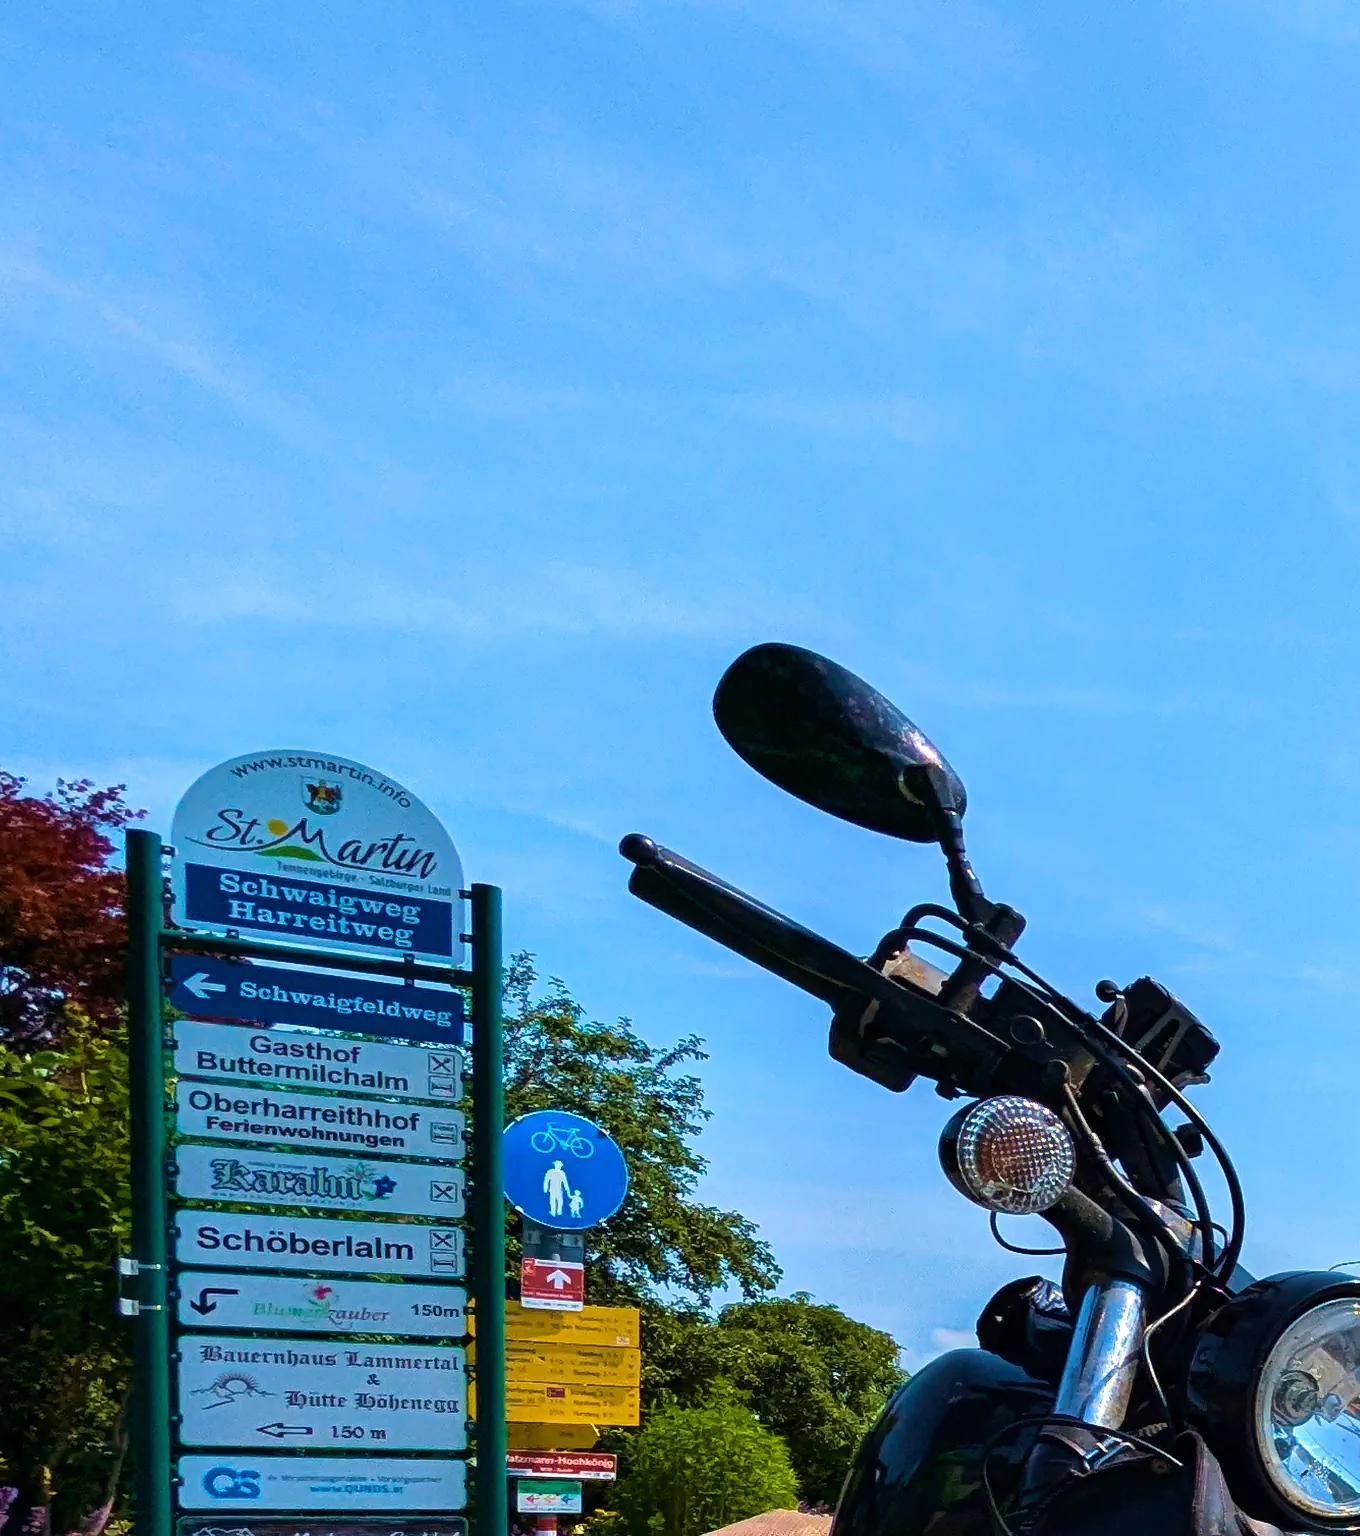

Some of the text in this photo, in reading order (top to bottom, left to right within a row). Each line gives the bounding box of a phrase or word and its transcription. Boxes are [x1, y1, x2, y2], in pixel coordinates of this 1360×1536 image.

[230, 756, 411, 809] www.stmartin.info
[206, 808, 438, 880] St. Martin
[220, 873, 421, 925] Schwaigweg
[428, 884, 452, 897] Land
[228, 899, 414, 948] Harreitweg
[240, 981, 452, 1027] Schwaigfeldweg
[250, 1035, 361, 1064] Gasthof
[197, 1051, 408, 1092] Buttermilchalm
[189, 1090, 420, 1131] Oberharreithhof
[207, 1116, 405, 1148] Ferienwohnungen
[210, 1158, 363, 1200] Karalm
[197, 1226, 414, 1260] Schöberlalm
[411, 1304, 460, 1318] 150m
[200, 1345, 458, 1370] Bauernhaus Lammertal
[366, 1373, 381, 1386] &
[285, 1390, 460, 1413] Hütte Höhenegg
[332, 1425, 387, 1440] 150 m
